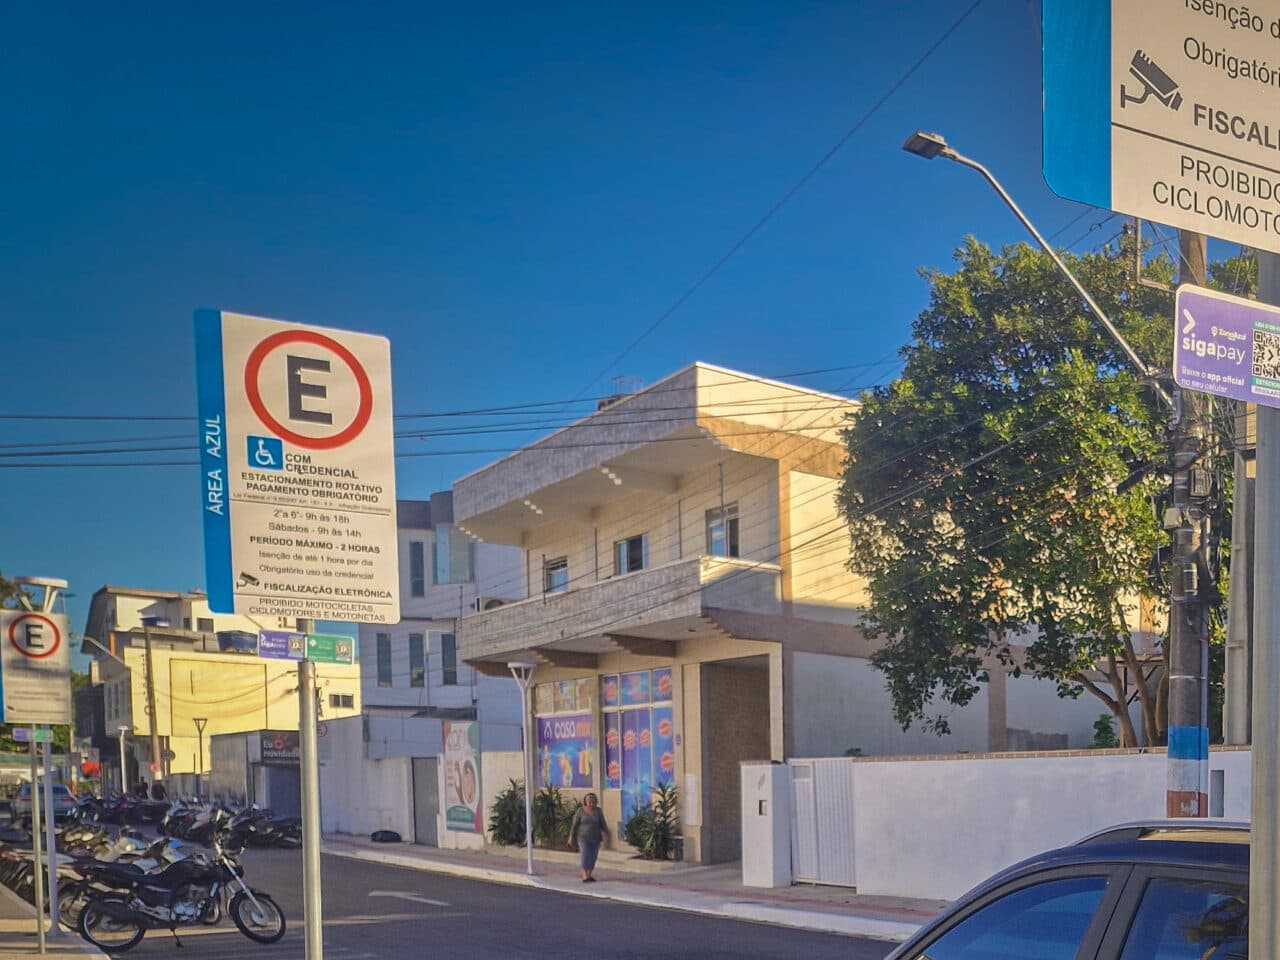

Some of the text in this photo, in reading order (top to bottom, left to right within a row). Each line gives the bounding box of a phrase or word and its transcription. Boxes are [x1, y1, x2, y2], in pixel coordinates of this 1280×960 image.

[1185, 0, 1263, 32] senção
[1182, 333, 1246, 365] sigapay
[1204, 382, 1228, 393] celular
[1207, 372, 1221, 383] app
[1222, 374, 1245, 386] oficial
[286, 354, 333, 425] E
[205, 414, 224, 516] ÁREA AZUL
[285, 453, 312, 465] COM
[285, 463, 359, 480] CREDENCIAL
[241, 471, 383, 495] ESTACIONAMENTO ROTATIVO
[246, 482, 379, 504] PAGAMENTO OBRIGATÓRIO
[305, 511, 350, 524] 9h às 18h
[268, 521, 362, 538] Sábados 9h às 14h
[249, 535, 381, 554] PERÍODO MÁXIMO 2 HORAS
[258, 550, 374, 567] Isenção de até 1 hora por dia
[258, 564, 375, 580] Obrigatório uso da credencial
[263, 582, 393, 599] FISCALIZAÇÃO ELETRÔNICA
[248, 605, 322, 619] CICLOMOTORES
[331, 611, 386, 622] MOTONETAS
[258, 597, 376, 613] PROIBIDO MOTOCICLETAS,
[25, 623, 45, 650] E
